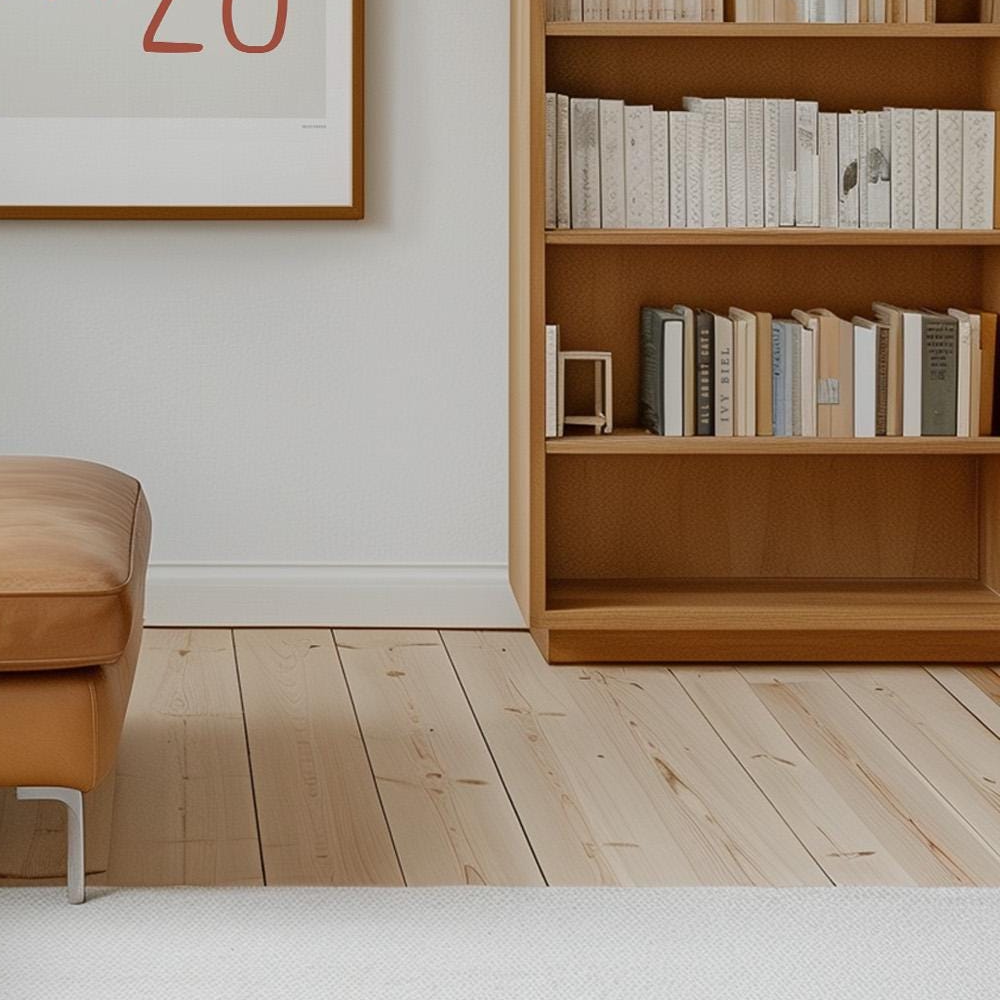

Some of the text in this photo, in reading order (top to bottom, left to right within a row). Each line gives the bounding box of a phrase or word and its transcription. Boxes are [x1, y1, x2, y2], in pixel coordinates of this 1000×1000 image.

[700, 329, 710, 424] ALL ABOUT CATS
[720, 347, 730, 422] IVY BIEL
